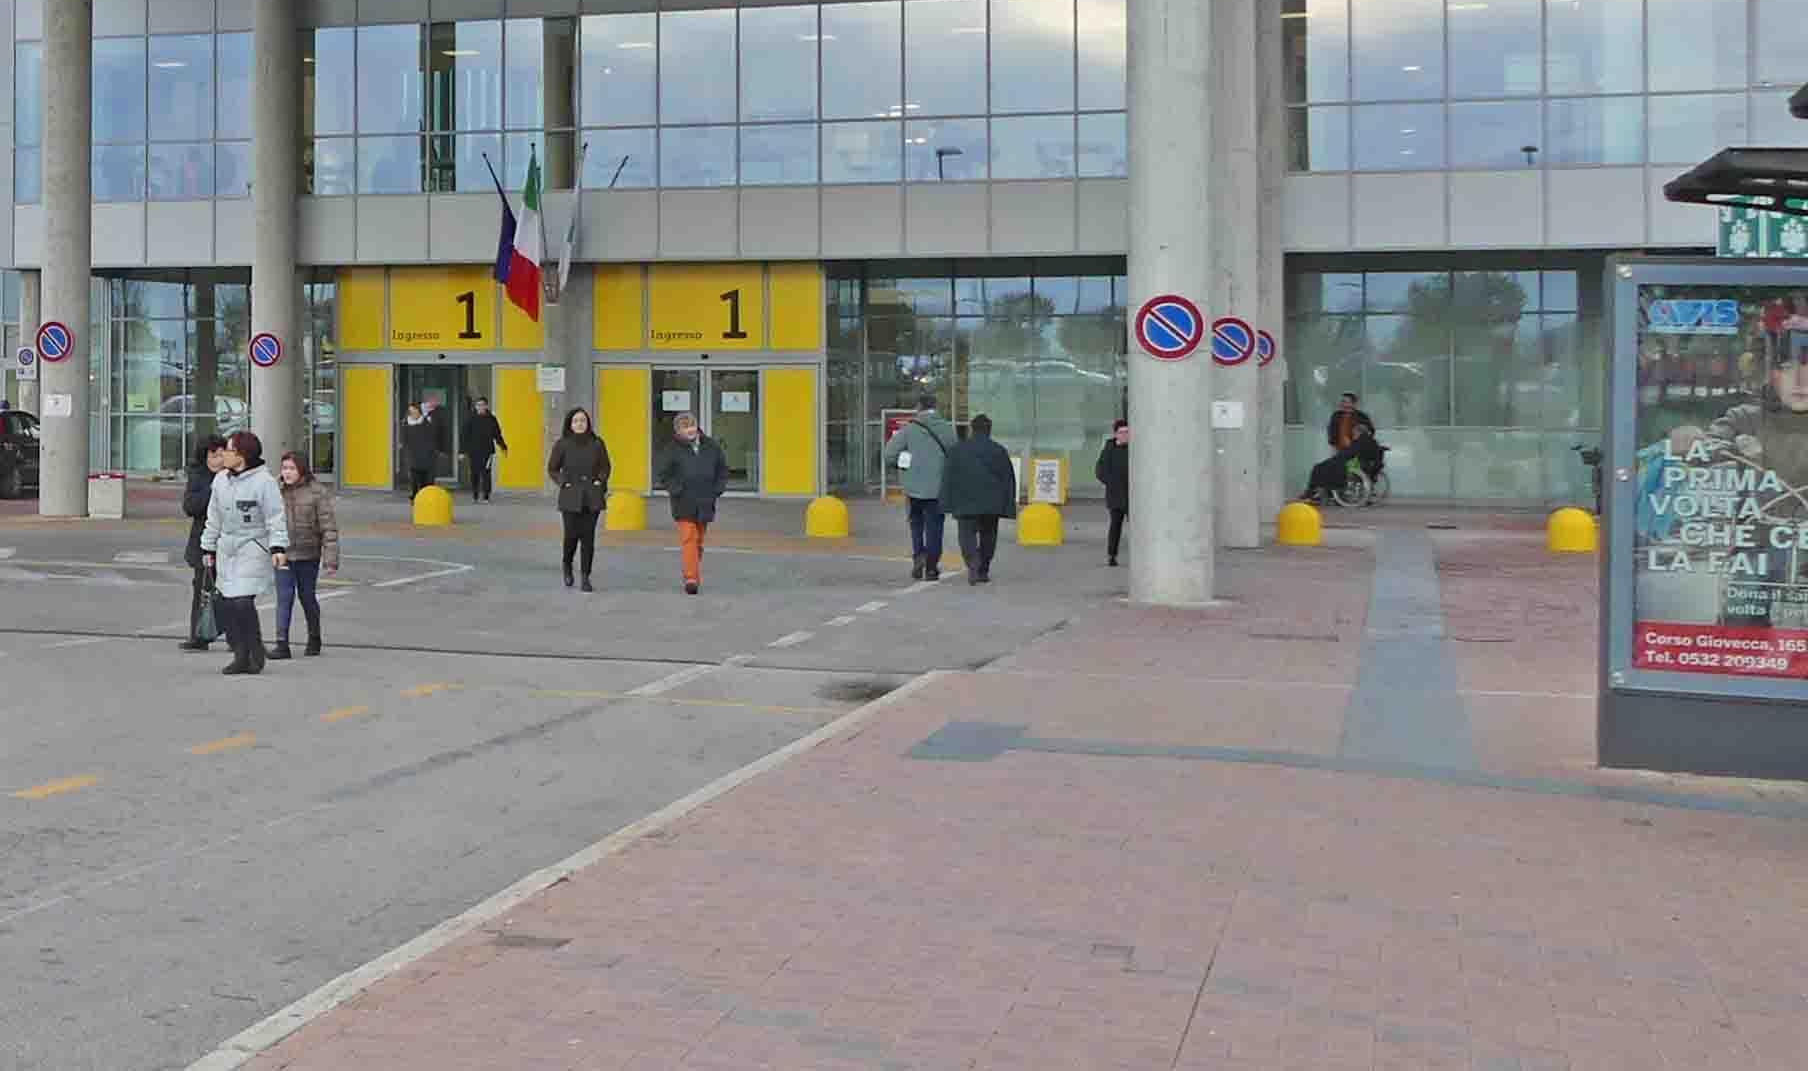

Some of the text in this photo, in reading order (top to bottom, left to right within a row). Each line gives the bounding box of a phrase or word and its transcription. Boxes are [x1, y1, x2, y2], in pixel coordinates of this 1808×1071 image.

[392, 290, 482, 342] Ingresso 1
[720, 290, 748, 339] 1
[1664, 440, 1712, 462] LA
[1664, 467, 1782, 491] PRIMA
[1648, 494, 1762, 518] VOLTA
[1681, 523, 1756, 547] CHE
[1648, 549, 1768, 575] LA FAI
[1645, 632, 1692, 646] Corso
[1646, 650, 1675, 664] Tel.
[1678, 653, 1720, 667] 0532
